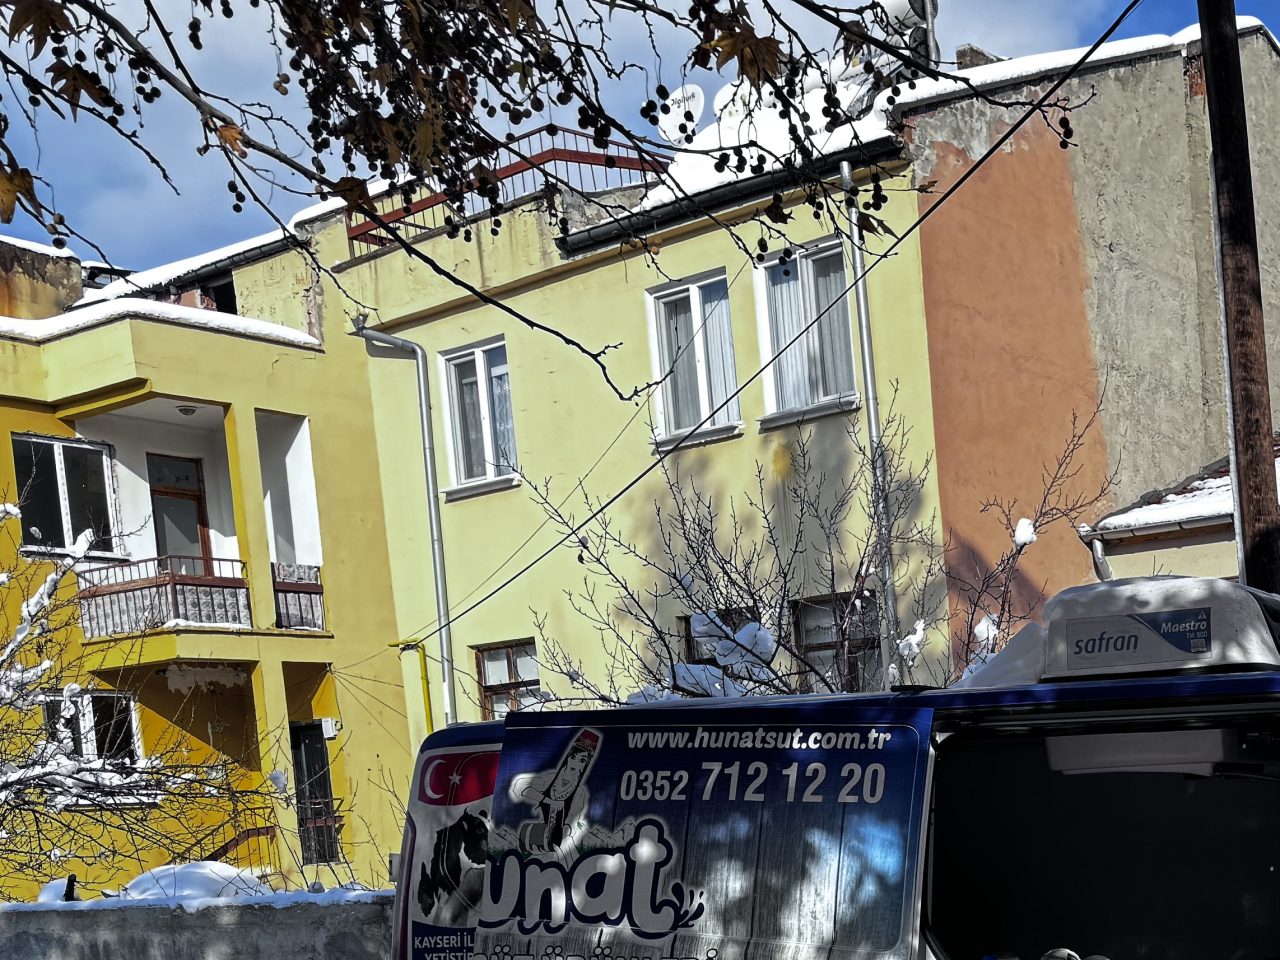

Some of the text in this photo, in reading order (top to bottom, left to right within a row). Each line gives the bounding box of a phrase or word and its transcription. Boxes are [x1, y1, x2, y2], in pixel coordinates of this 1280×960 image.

[1160, 620, 1207, 634] Maestro
[1073, 631, 1139, 655] safran
[627, 727, 892, 749] www.hunatsut.com.tr
[619, 761, 886, 804] 0352 712 12 20
[414, 931, 462, 949] KAYSERİ
